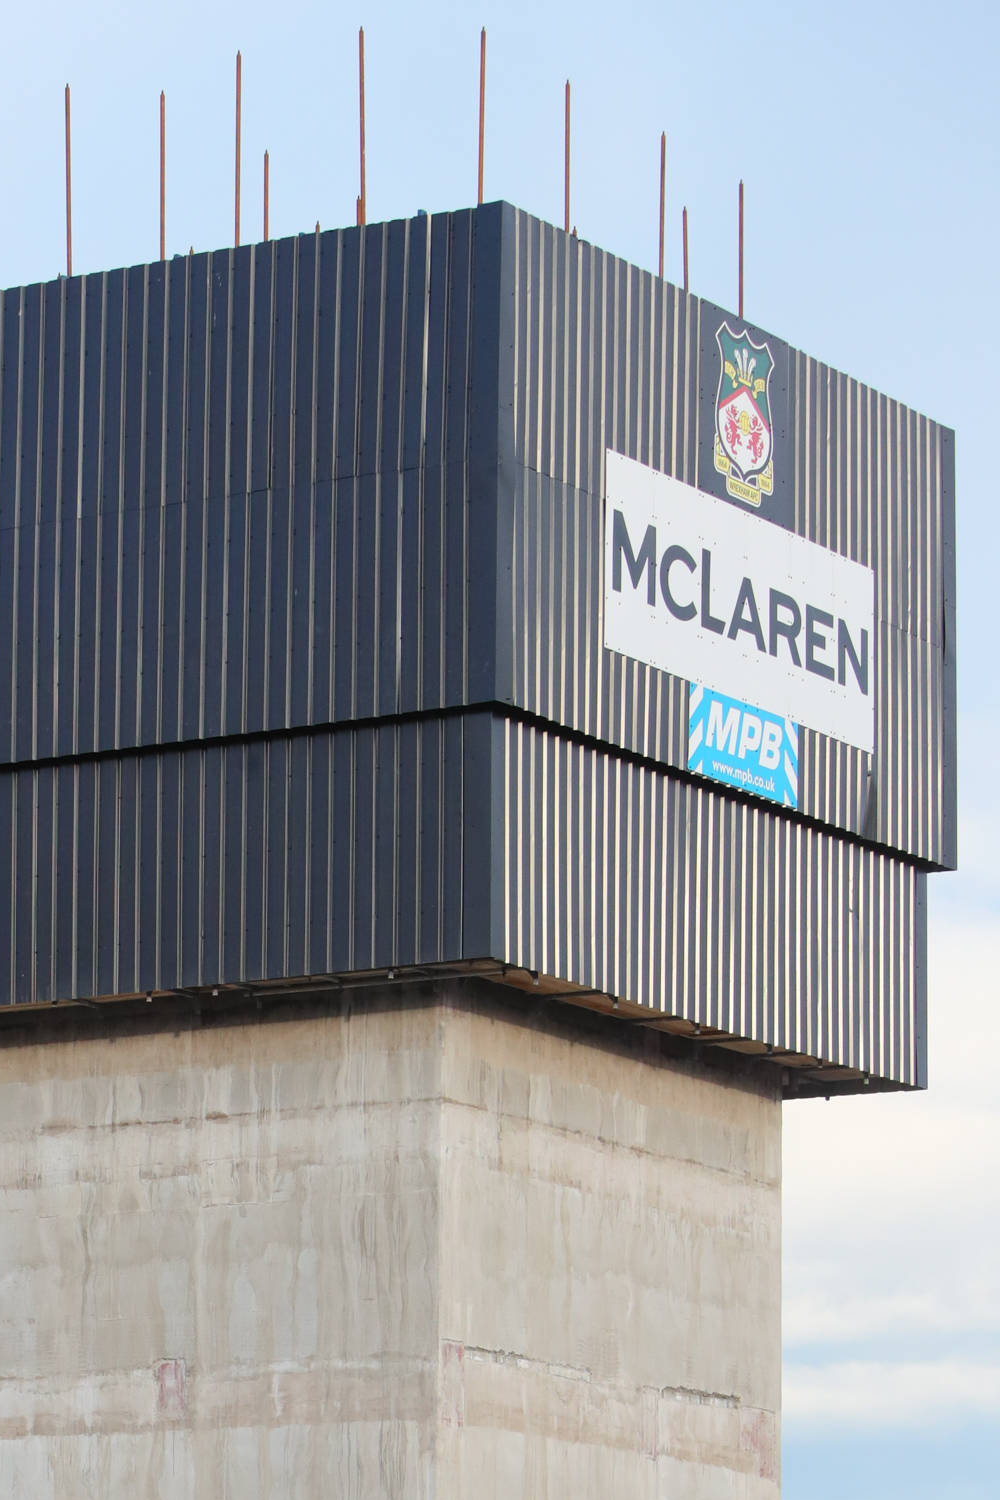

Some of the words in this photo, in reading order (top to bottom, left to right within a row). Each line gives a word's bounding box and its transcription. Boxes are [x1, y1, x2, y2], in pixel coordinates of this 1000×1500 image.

[612, 509, 868, 696] MCLAREN
[705, 700, 783, 770] MPB
[712, 760, 775, 792] www.mpb.co.uk
